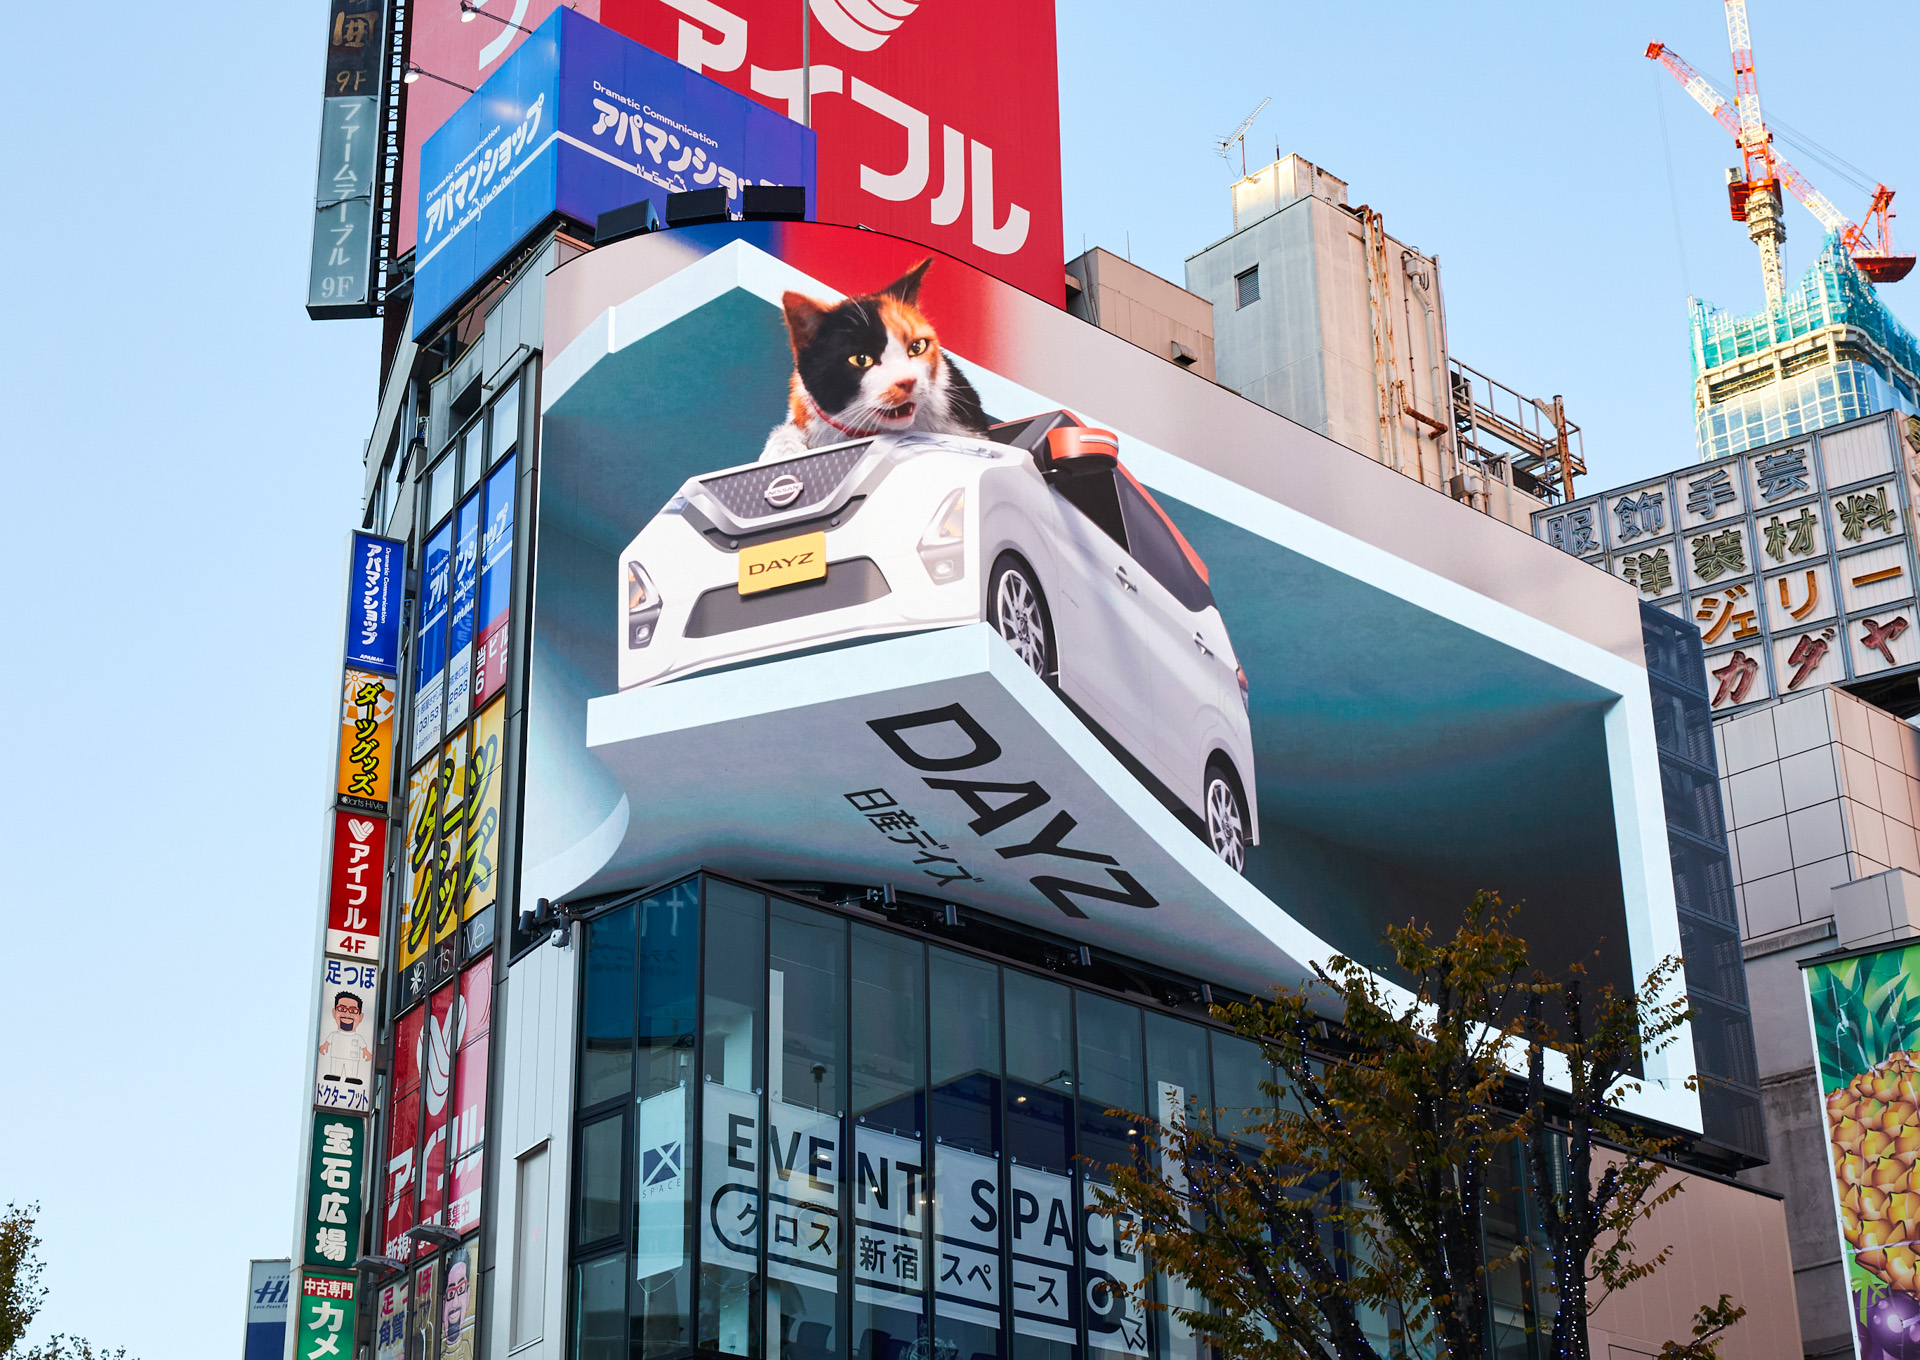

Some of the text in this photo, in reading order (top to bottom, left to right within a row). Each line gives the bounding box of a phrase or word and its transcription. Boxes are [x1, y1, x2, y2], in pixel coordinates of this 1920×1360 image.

[336, 69, 368, 92] 9F
[593, 80, 719, 149] Dramatic Communication
[328, 103, 362, 267] ファームテーブル
[425, 92, 545, 243] アパマンショップ
[426, 125, 501, 202] Dramatic Communication
[592, 97, 786, 200] アパマンショ
[321, 275, 354, 299] 9F
[768, 485, 799, 496] NISSAN
[1547, 448, 1809, 555] 服飾手芸
[428, 501, 509, 610] アパンシップ
[749, 552, 814, 576] DAYZ
[1622, 486, 1896, 595] 洋装材料
[361, 543, 382, 645] アパマンショップ
[452, 598, 475, 627] APAMA
[1711, 615, 1909, 708] カダヤ
[348, 683, 385, 796] ダーツグッズ
[843, 788, 984, 887] 日産デイズ
[866, 702, 1160, 919] DAYZ
[343, 842, 370, 930] アイフル
[325, 960, 377, 989] 足つぼ
[339, 935, 366, 954] 4F
[412, 948, 451, 996] Drts
[316, 1083, 369, 1111] ドクターフット
[315, 1122, 354, 1262] 宝石広場
[642, 1178, 681, 1199] SPACE
[728, 1112, 1137, 1264] EVENT SPACE
[303, 1278, 354, 1300] 中古専門
[378, 1299, 432, 1351] 角質ア
[307, 1301, 344, 1360] カメ
